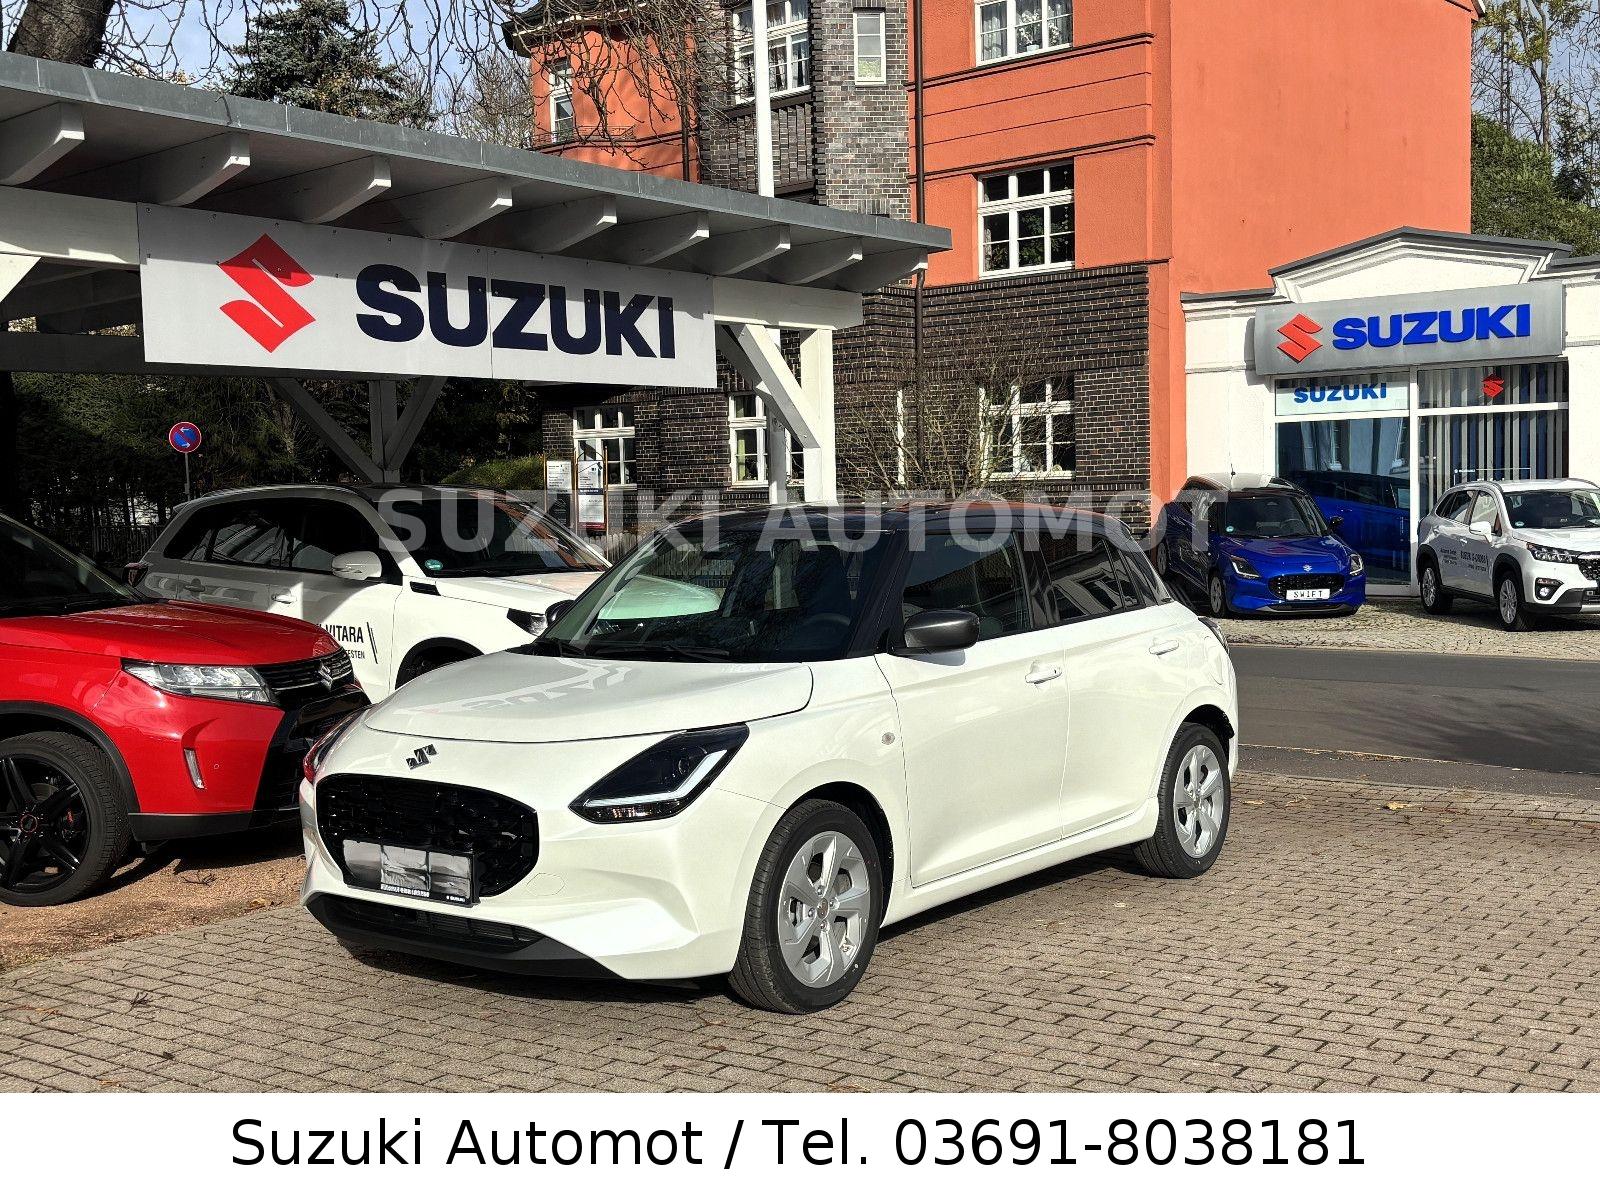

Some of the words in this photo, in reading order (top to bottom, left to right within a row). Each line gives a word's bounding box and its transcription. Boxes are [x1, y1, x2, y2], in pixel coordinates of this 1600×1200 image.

[356, 263, 676, 359] SUZUKI
[1332, 303, 1531, 351] SUZUKI
[1293, 382, 1387, 404] SUZUKI
[1293, 590, 1322, 598] SWIFT
